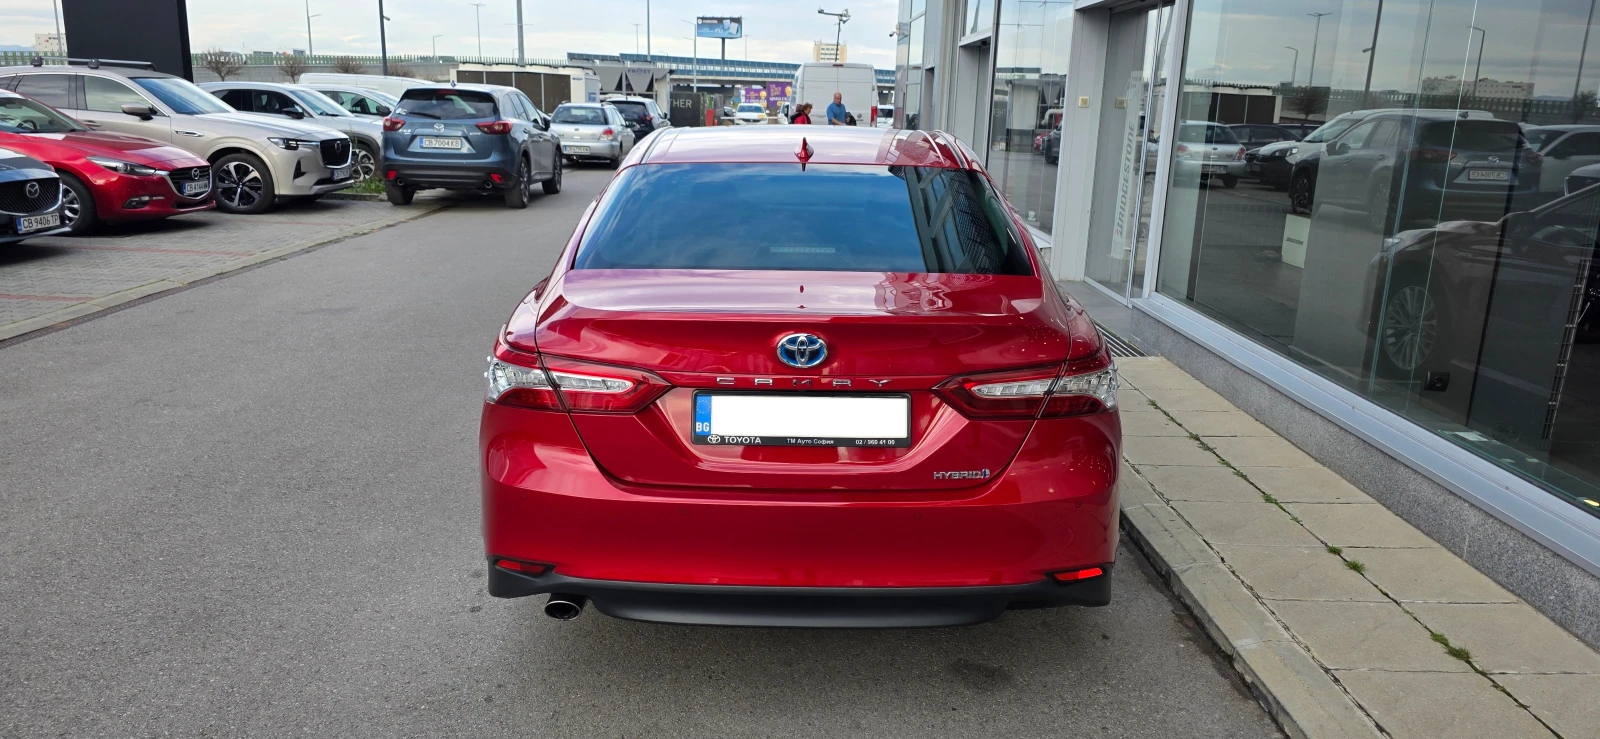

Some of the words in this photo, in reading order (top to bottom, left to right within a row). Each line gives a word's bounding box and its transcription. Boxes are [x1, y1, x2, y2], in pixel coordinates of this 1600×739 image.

[1117, 121, 1135, 238] BRIDGESTONE
[22, 218, 34, 229] CB
[34, 216, 51, 227] 9406
[716, 377, 892, 387] CAMRY
[695, 421, 710, 433] BG
[724, 436, 762, 444] TOYOTA
[813, 438, 834, 446] София
[933, 470, 982, 479] HYBRID
